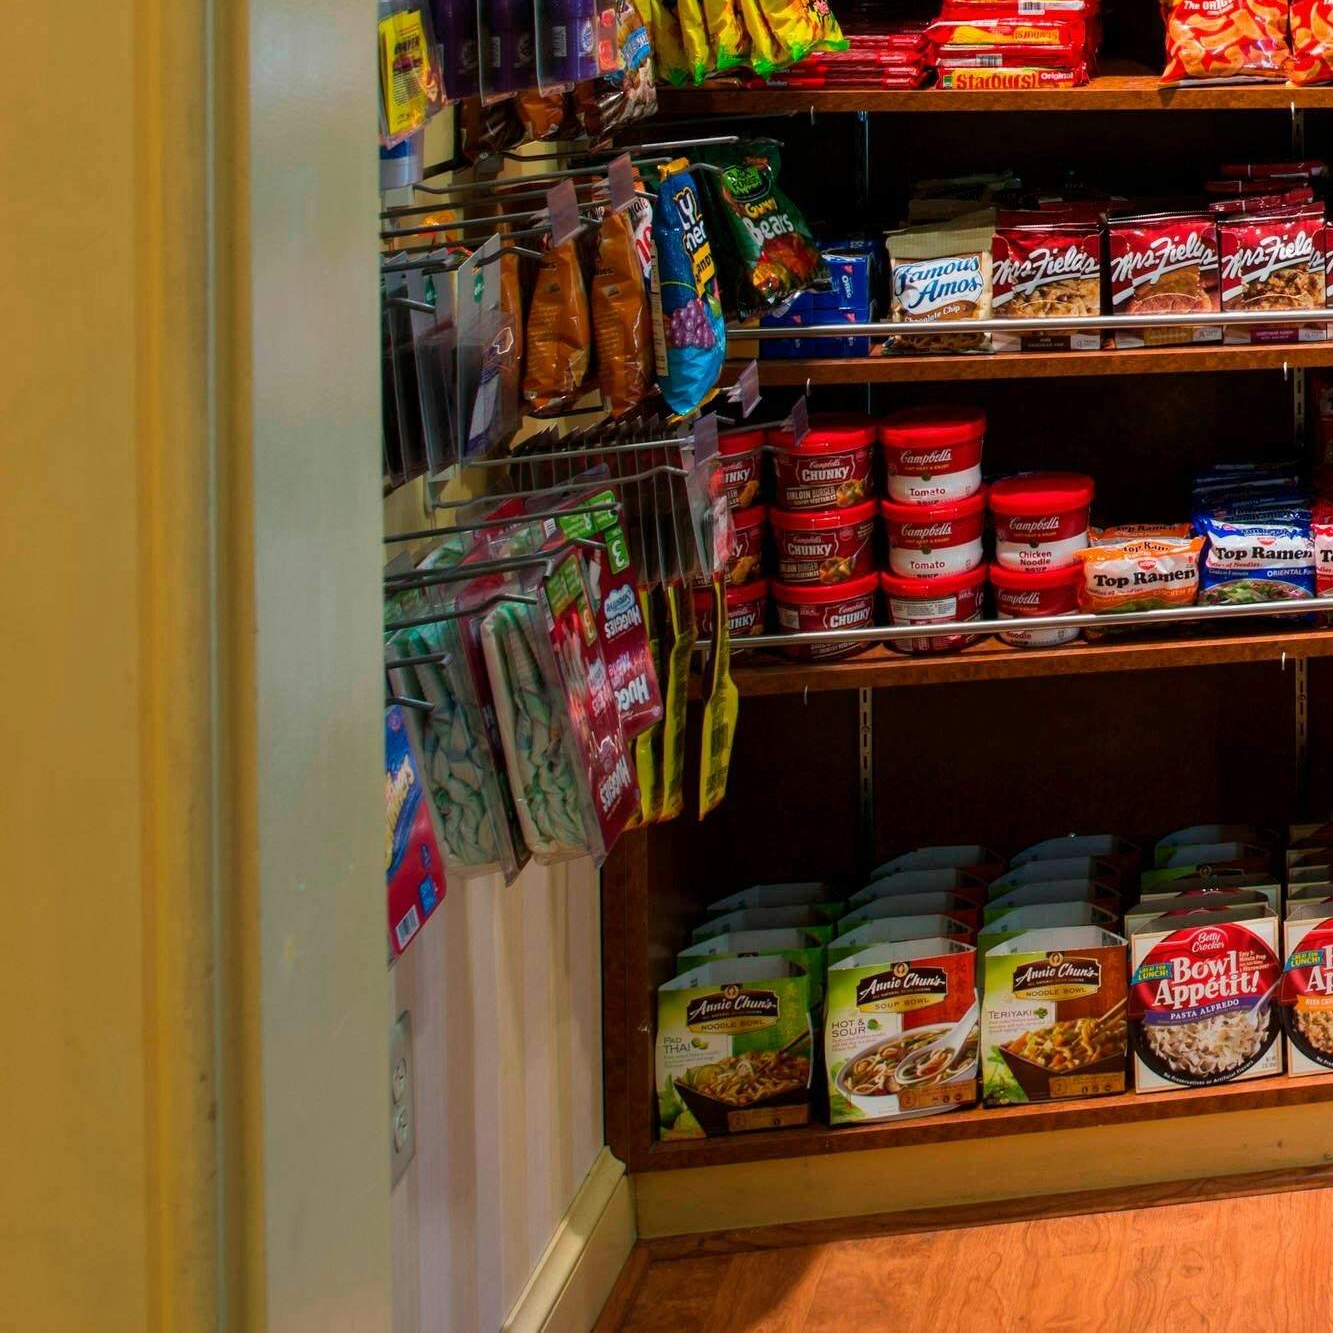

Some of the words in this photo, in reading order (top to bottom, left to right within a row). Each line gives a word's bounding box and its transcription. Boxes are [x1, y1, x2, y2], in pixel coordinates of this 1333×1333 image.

[1184, 0, 1200, 11] The
[1041, 71, 1074, 82] Original
[743, 213, 795, 247] Bears
[894, 255, 980, 296] Famous
[1028, 245, 1100, 295] Fields
[908, 277, 983, 309] Amos
[943, 304, 961, 315] Chip
[801, 466, 851, 482] CHUNKY
[909, 487, 946, 497] Tomato
[787, 540, 833, 556] CHUNKY
[1018, 550, 1052, 559] Chicken
[1216, 547, 1248, 563] Top
[1252, 546, 1313, 560] Ramen
[910, 559, 946, 570] Tomato
[1019, 557, 1051, 566] Noodle
[1093, 574, 1129, 589] Top
[1132, 568, 1196, 585] Ramen
[1266, 569, 1302, 578] ORIENTAL
[829, 608, 871, 628] CHUNKY
[1197, 931, 1221, 944] Betty
[1015, 966, 1057, 983] Annie
[1057, 963, 1100, 978] Chun's
[1169, 950, 1240, 985] Bowl
[858, 979, 902, 1001] Annie
[902, 971, 946, 989] Chun's
[1025, 990, 1061, 999] NOODLE
[1062, 987, 1087, 996] BOWL
[688, 997, 732, 1017] Annie
[733, 993, 778, 1011] Chun's
[874, 1000, 900, 1010] SOUP
[904, 997, 930, 1007] BOWL
[1170, 1011, 1198, 1021] PASTA
[1199, 998, 1240, 1016] ALFREDO
[988, 1009, 1033, 1020] TERIYAKI
[701, 1022, 737, 1032] NOODLE
[740, 1018, 765, 1028] BOWL
[831, 1020, 852, 1030] HOT
[855, 1018, 865, 1028] &
[831, 1027, 867, 1038] SOUR
[663, 1043, 691, 1054] THAI
